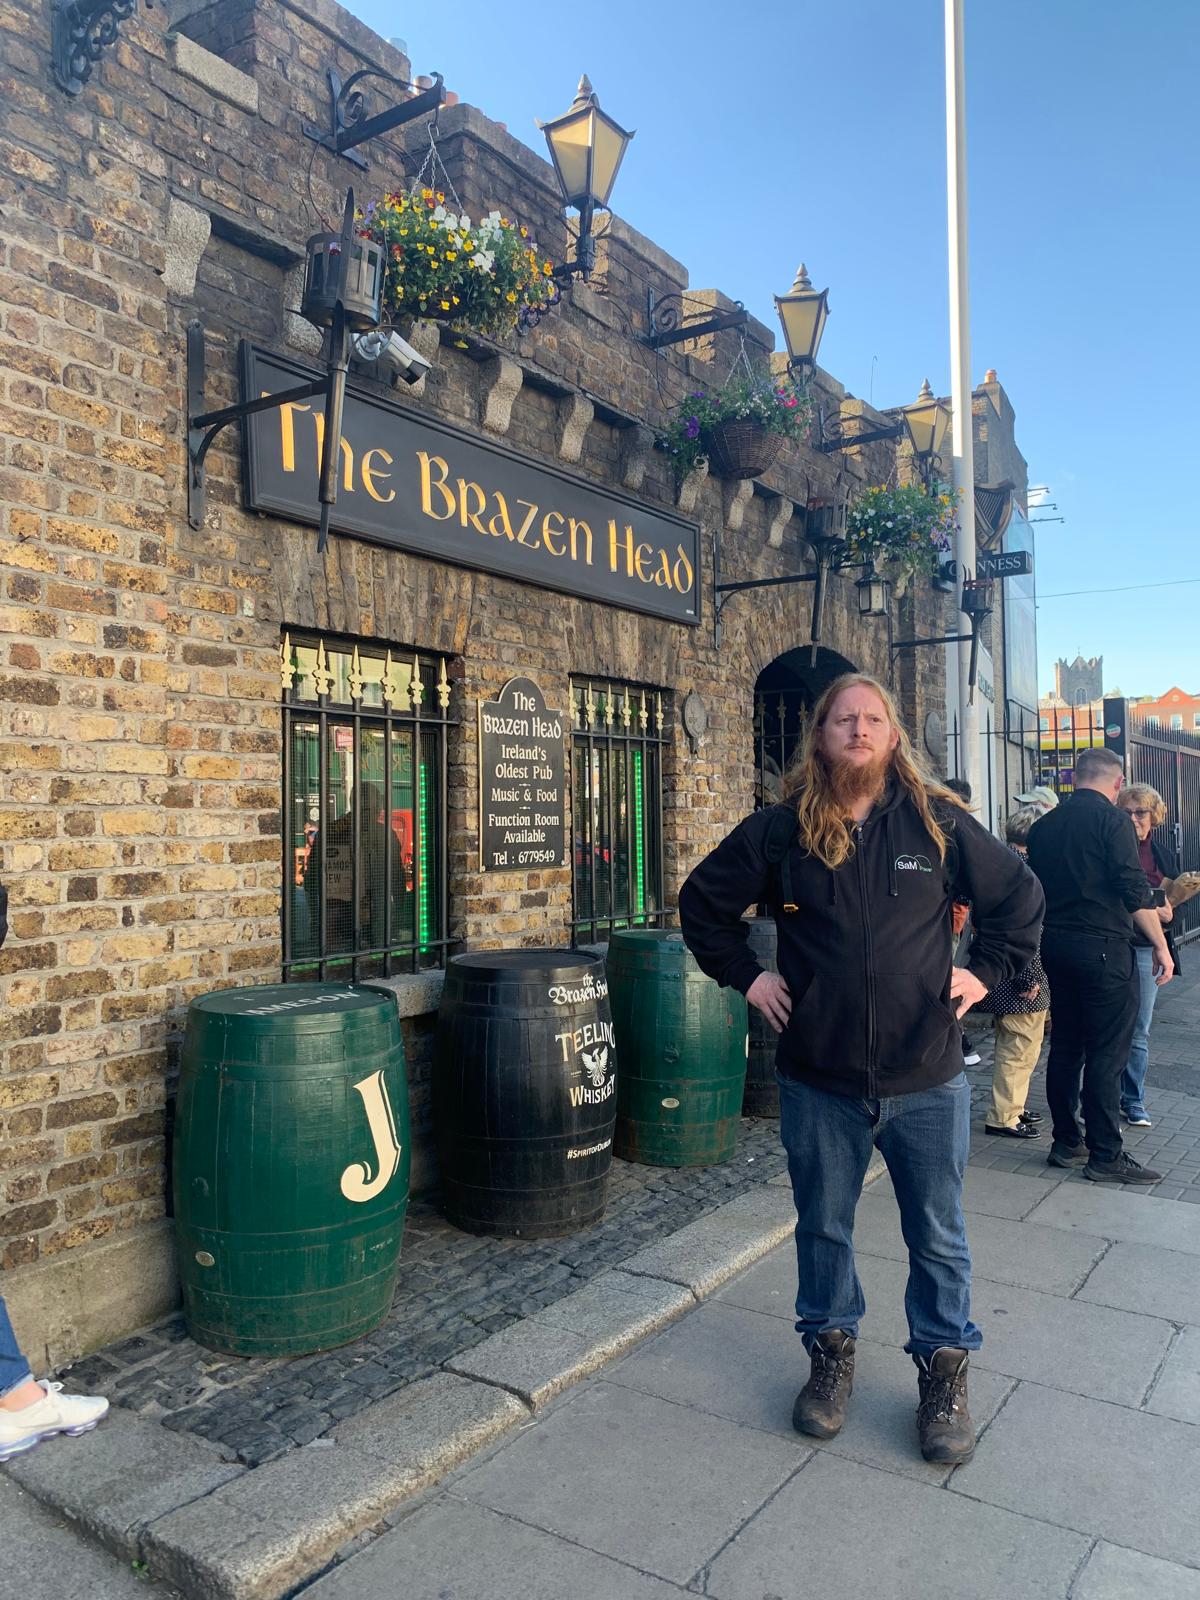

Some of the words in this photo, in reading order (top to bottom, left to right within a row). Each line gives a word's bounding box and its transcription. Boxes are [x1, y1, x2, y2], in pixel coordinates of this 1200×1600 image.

[261, 391, 396, 503] The
[512, 691, 536, 712] The
[501, 744, 547, 761] Ireland's
[495, 763, 529, 780] Oldest
[533, 765, 553, 780] Pub
[491, 787, 520, 802] Music
[523, 788, 532, 802] &
[536, 788, 557, 802] Food
[488, 813, 531, 827] Function
[534, 813, 560, 826] Room
[503, 829, 546, 844] Available
[518, 850, 555, 864] 6779549
[340, 1069, 402, 1203] J
